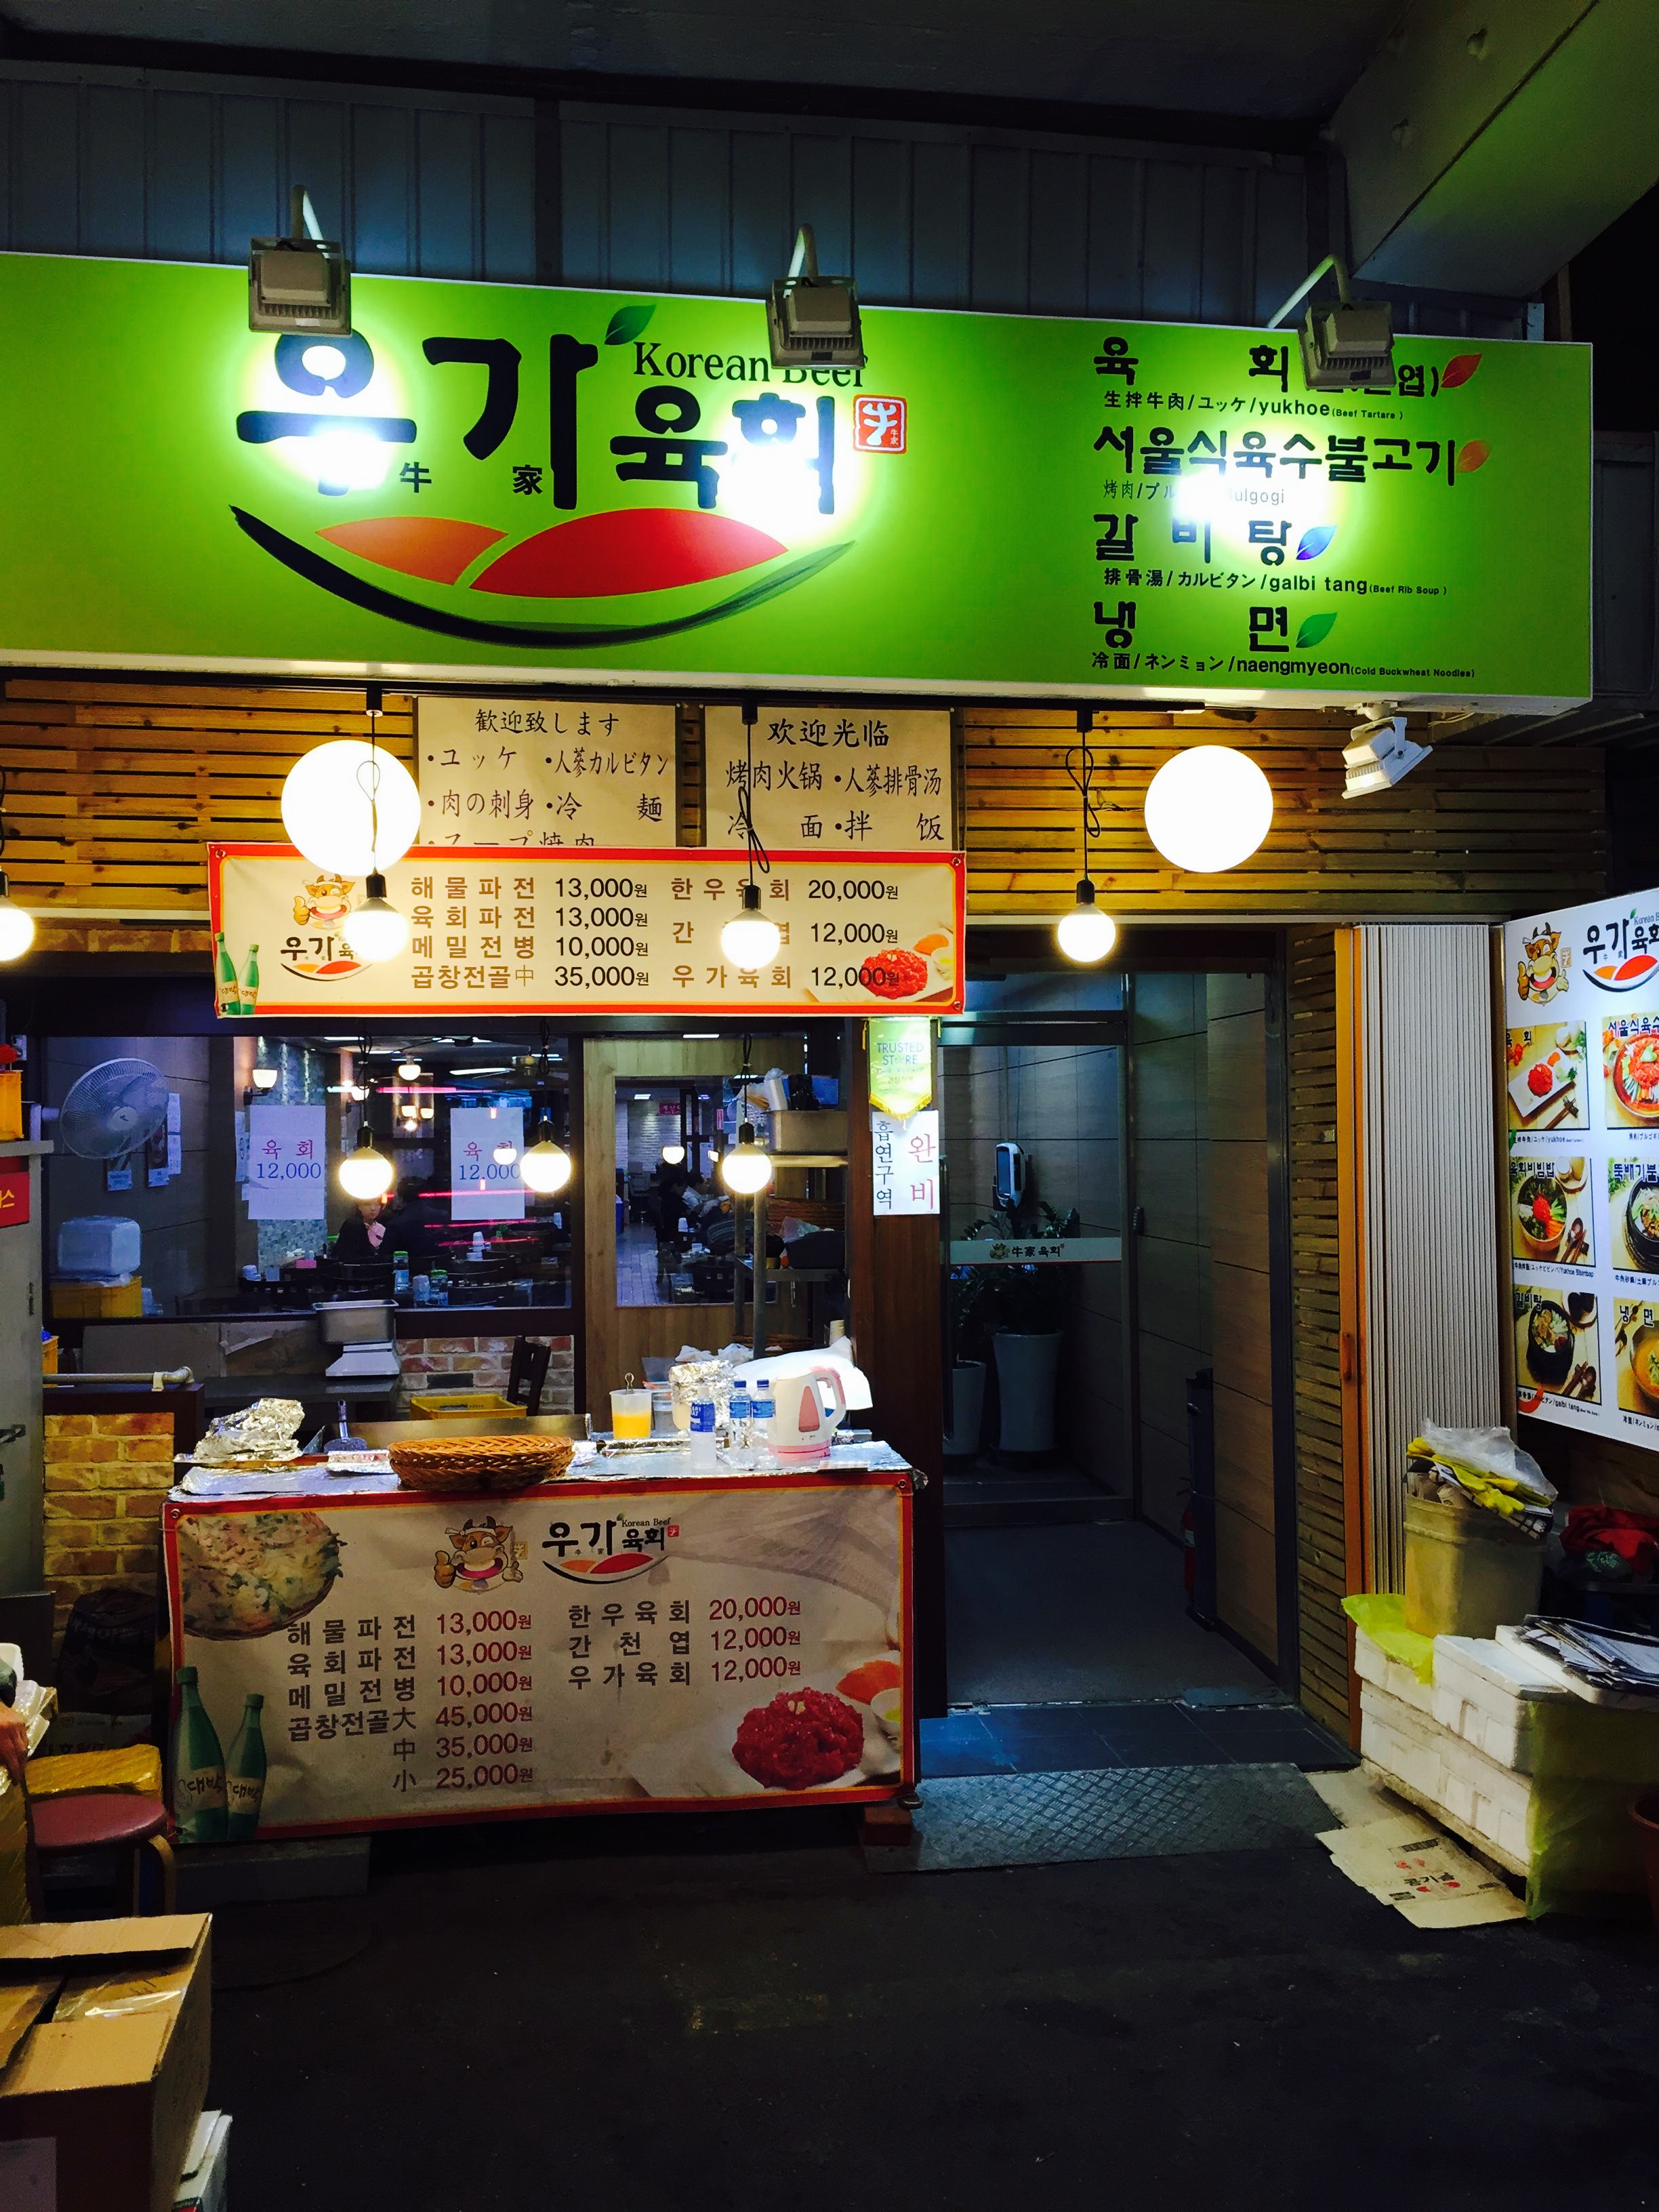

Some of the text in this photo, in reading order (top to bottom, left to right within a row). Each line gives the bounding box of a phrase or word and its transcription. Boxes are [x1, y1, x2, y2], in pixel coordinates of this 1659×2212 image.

[633, 342, 771, 382] Korean
[1325, 577, 1368, 595] tang
[767, 718, 890, 748] 欢迎光临
[555, 878, 649, 901] 13,000원
[808, 880, 899, 901] 20,000원
[555, 907, 649, 930] 13,000원
[811, 922, 899, 945] 12,000원
[556, 937, 649, 960] 10,000원
[554, 966, 649, 989] 35,000원
[811, 966, 901, 989] 12,000원
[876, 1042, 924, 1053] TRUSTED
[257, 1162, 322, 1181] 12,000
[621, 1517, 672, 1528] Korean Beef
[709, 1597, 802, 1620] 20,000원
[436, 1610, 532, 1635] 13,000원
[711, 1626, 801, 1652] 12,000원
[436, 1641, 532, 1666] 13,000원
[711, 1656, 802, 1682] 12,000원
[437, 1671, 533, 1697] 10,000원
[436, 1702, 533, 1729] 45,000원
[392, 1733, 533, 1762] 中 35,000원
[392, 1763, 534, 1793] 小 25,000원
